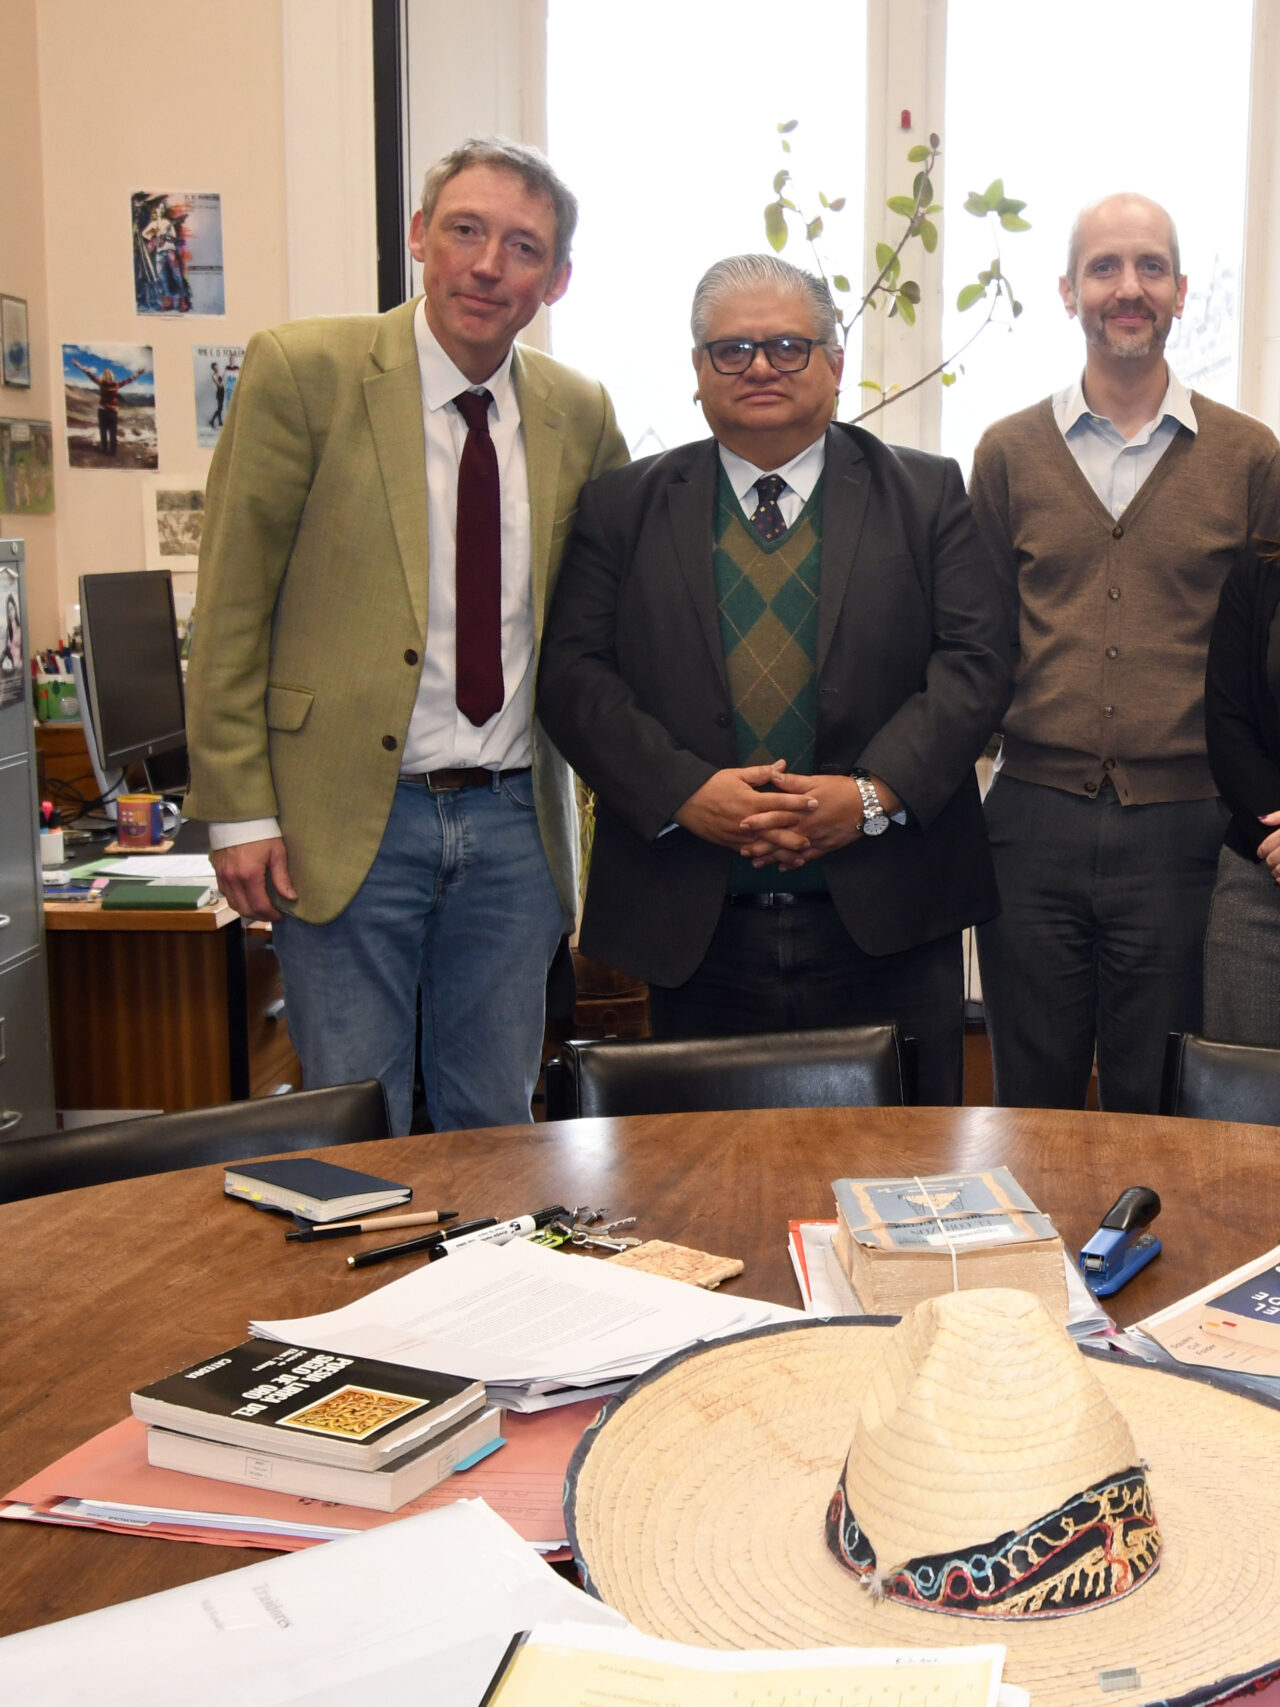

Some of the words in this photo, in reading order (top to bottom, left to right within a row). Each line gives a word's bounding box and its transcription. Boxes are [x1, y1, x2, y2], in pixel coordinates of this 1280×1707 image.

[291, 1354, 336, 1375] SIGLO
[270, 1373, 300, 1386] DE
[241, 1384, 277, 1400] ORO
[231, 1403, 268, 1417] DEL
